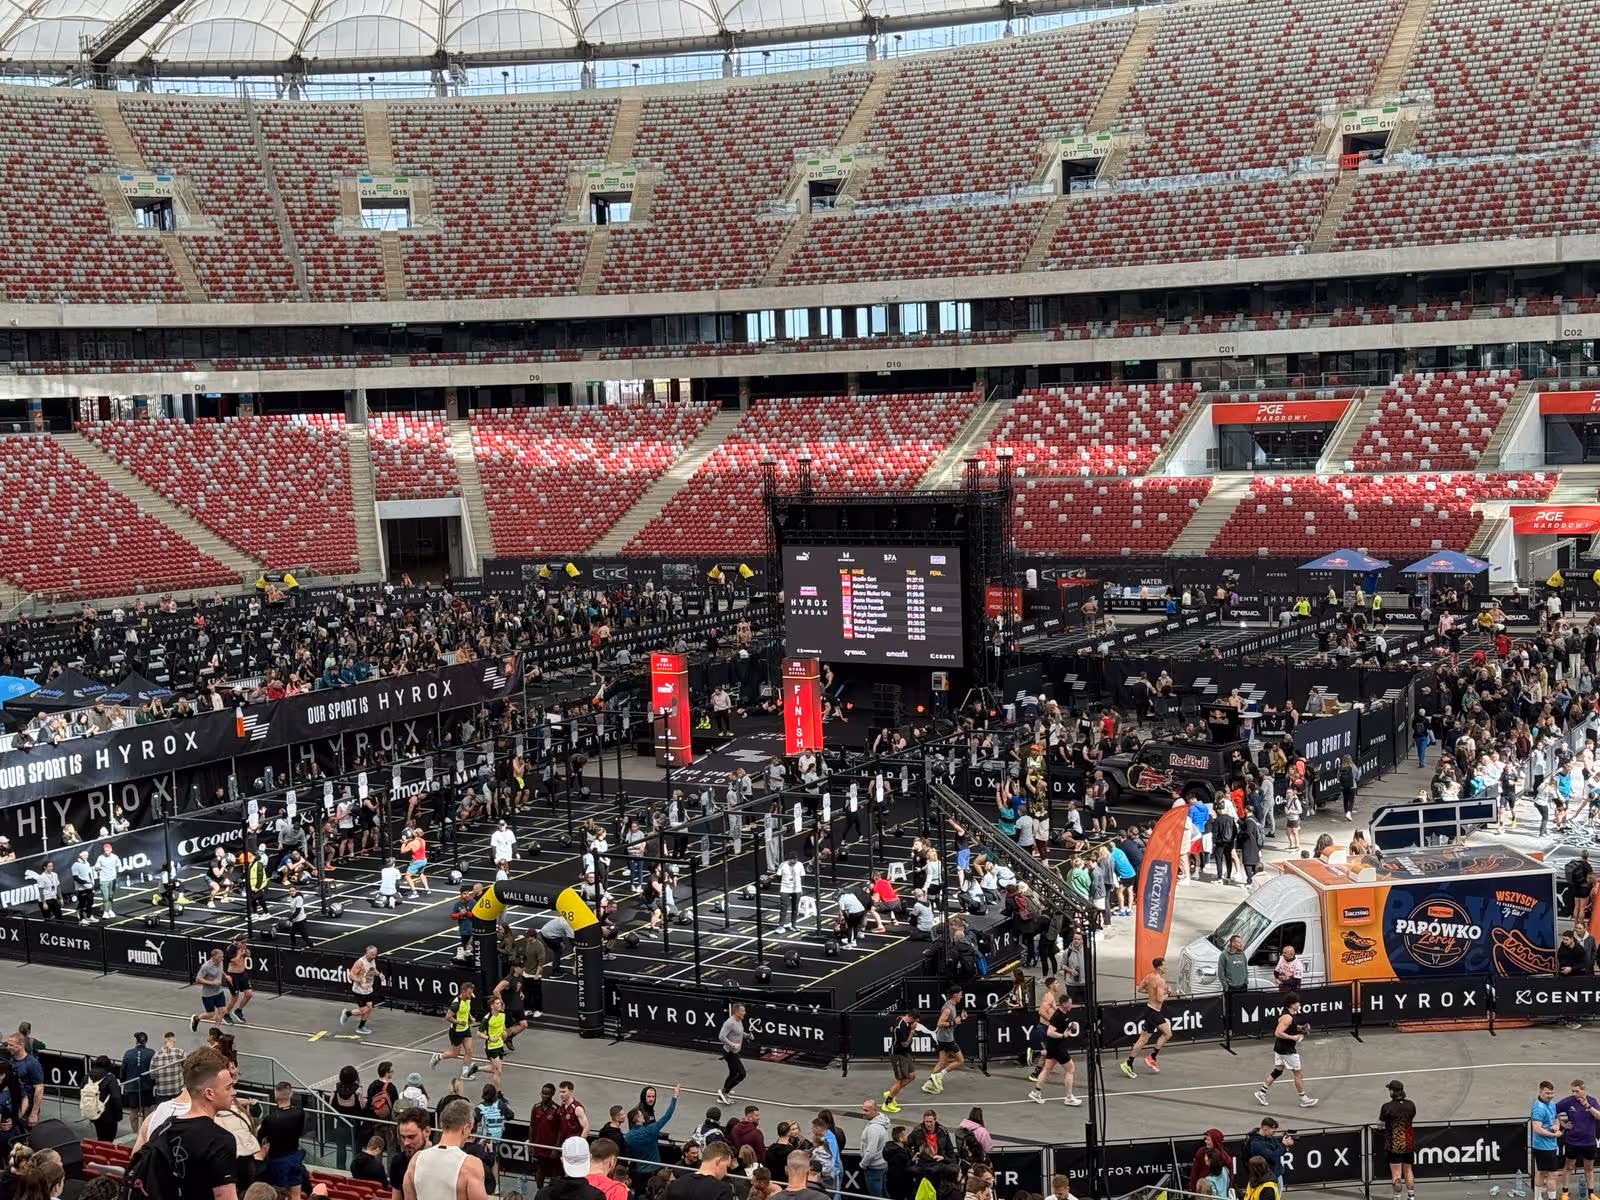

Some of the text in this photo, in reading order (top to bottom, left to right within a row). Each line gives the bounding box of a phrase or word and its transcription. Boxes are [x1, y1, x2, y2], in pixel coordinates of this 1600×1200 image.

[1564, 328, 1583, 337] C02
[1255, 414, 1308, 422] NARODOWY
[1257, 404, 1285, 415] PGE
[1535, 511, 1564, 522] PGE
[307, 679, 453, 725] OUR SPORT IS HYROX
[794, 684, 804, 748] FINISH
[1305, 730, 1351, 760] OUR SPORT IS
[0, 730, 199, 790] OUR SPORT IS HYROX
[669, 776, 725, 784] HYRO
[16, 775, 173, 837] HYROX
[503, 891, 549, 905] WALL BALLS
[1147, 863, 1168, 930] TARCZYŃSKI
[1495, 890, 1538, 909] WSZYSCY
[1395, 918, 1482, 940] PARÓWKO
[51, 931, 91, 951] CENTR
[128, 949, 158, 965] PUMA
[199, 950, 269, 972] HOX
[398, 974, 459, 996] HYRO
[578, 980, 586, 1008] BALLS
[1371, 990, 1476, 1010] HYROX
[628, 1002, 716, 1028] HYROX
[765, 1021, 825, 1041] CENTR
[1413, 1137, 1500, 1165] mazfit
[1108, 1166, 1132, 1176] FOR
